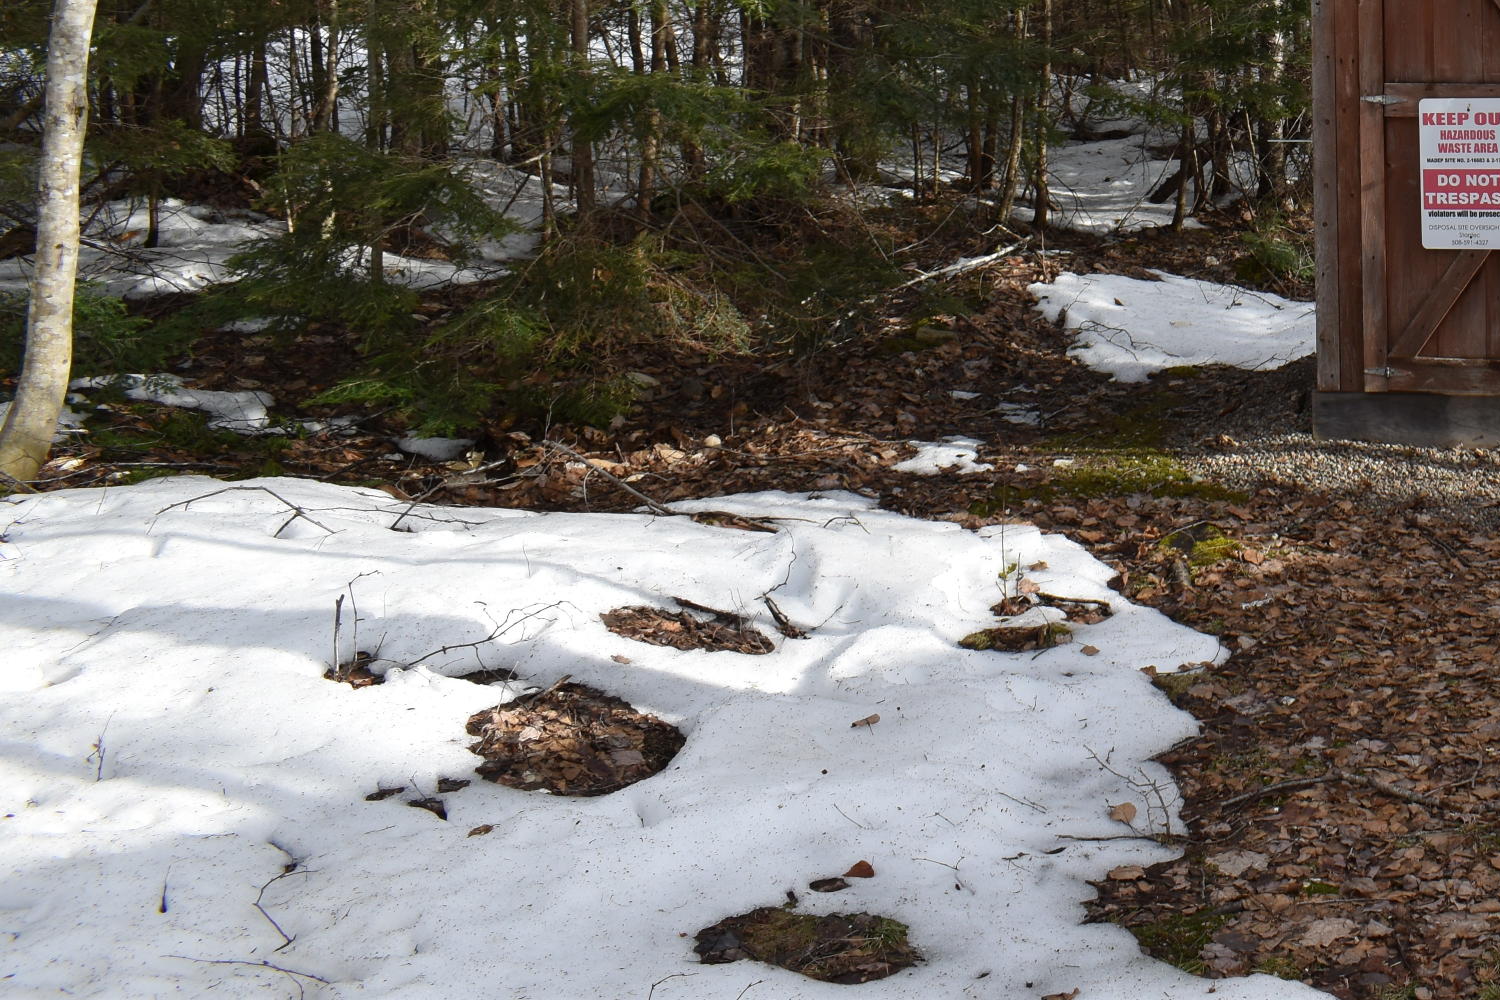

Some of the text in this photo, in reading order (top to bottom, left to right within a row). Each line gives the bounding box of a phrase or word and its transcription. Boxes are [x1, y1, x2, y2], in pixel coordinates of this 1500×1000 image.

[1422, 112, 1469, 126] KEEP
[1440, 130, 1496, 141] HAZARDOUS
[1438, 142, 1499, 154] WASTE AREA
[1437, 174, 1500, 187] DO NOT
[1428, 210, 1456, 218] violators
